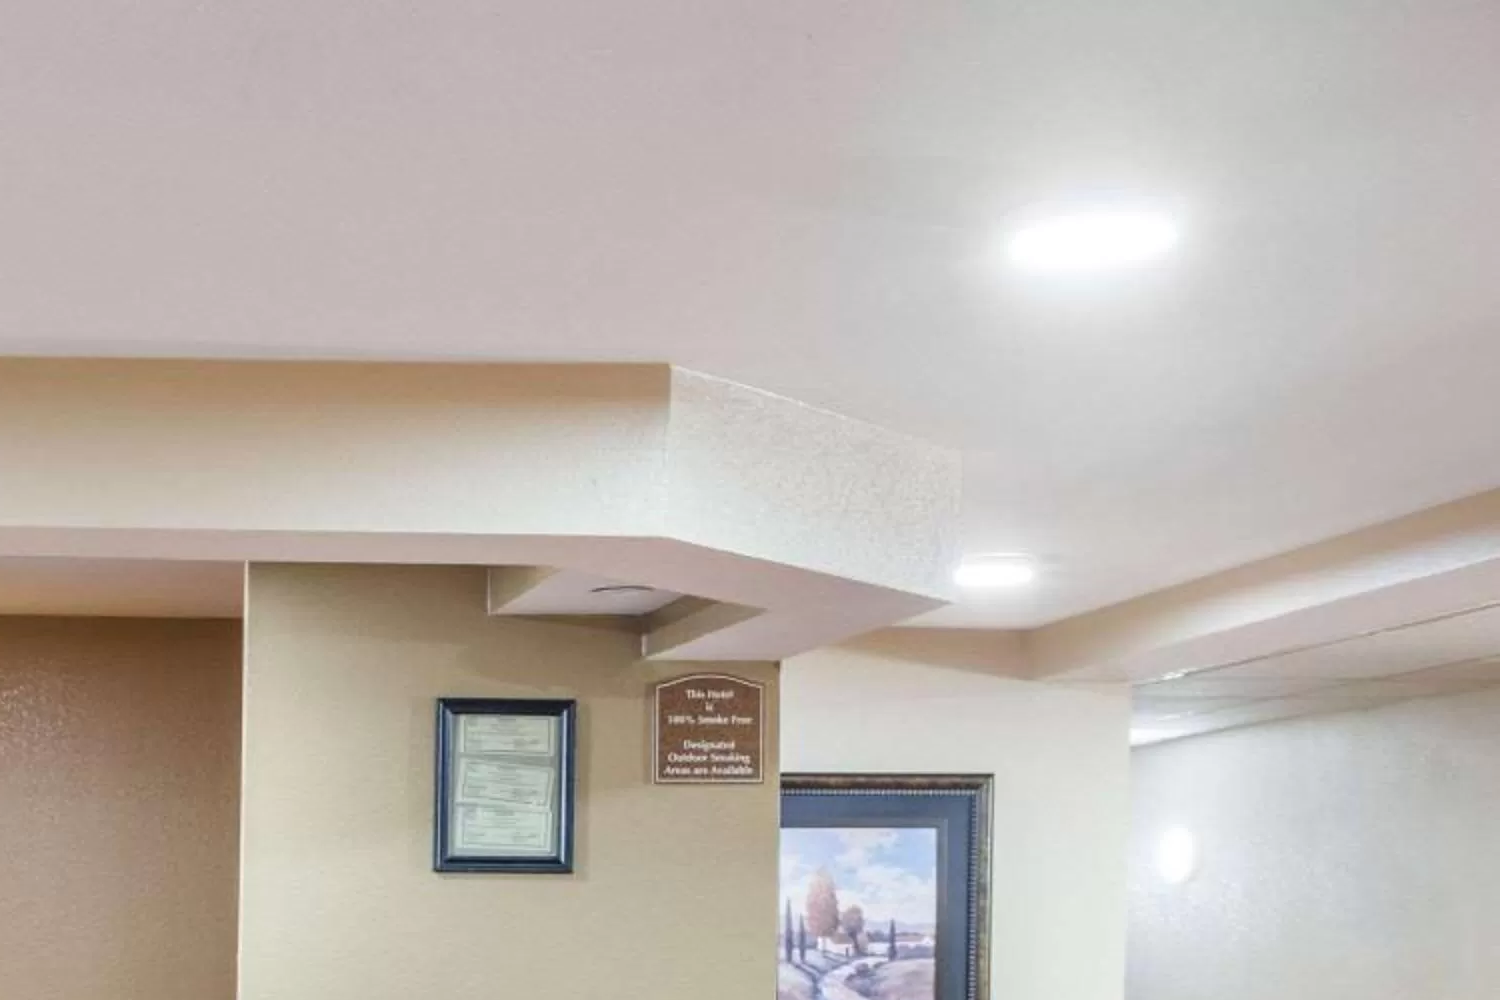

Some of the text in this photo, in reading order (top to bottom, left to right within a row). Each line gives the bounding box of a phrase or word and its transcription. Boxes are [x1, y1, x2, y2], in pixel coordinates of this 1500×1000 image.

[686, 689, 735, 700] This Hotel
[705, 701, 713, 712] is
[667, 715, 696, 725] 100%
[697, 714, 729, 725] Smoke
[683, 739, 736, 753] Designated
[667, 752, 751, 765] Outdoor Smoking
[663, 765, 754, 776] Areas are Available
